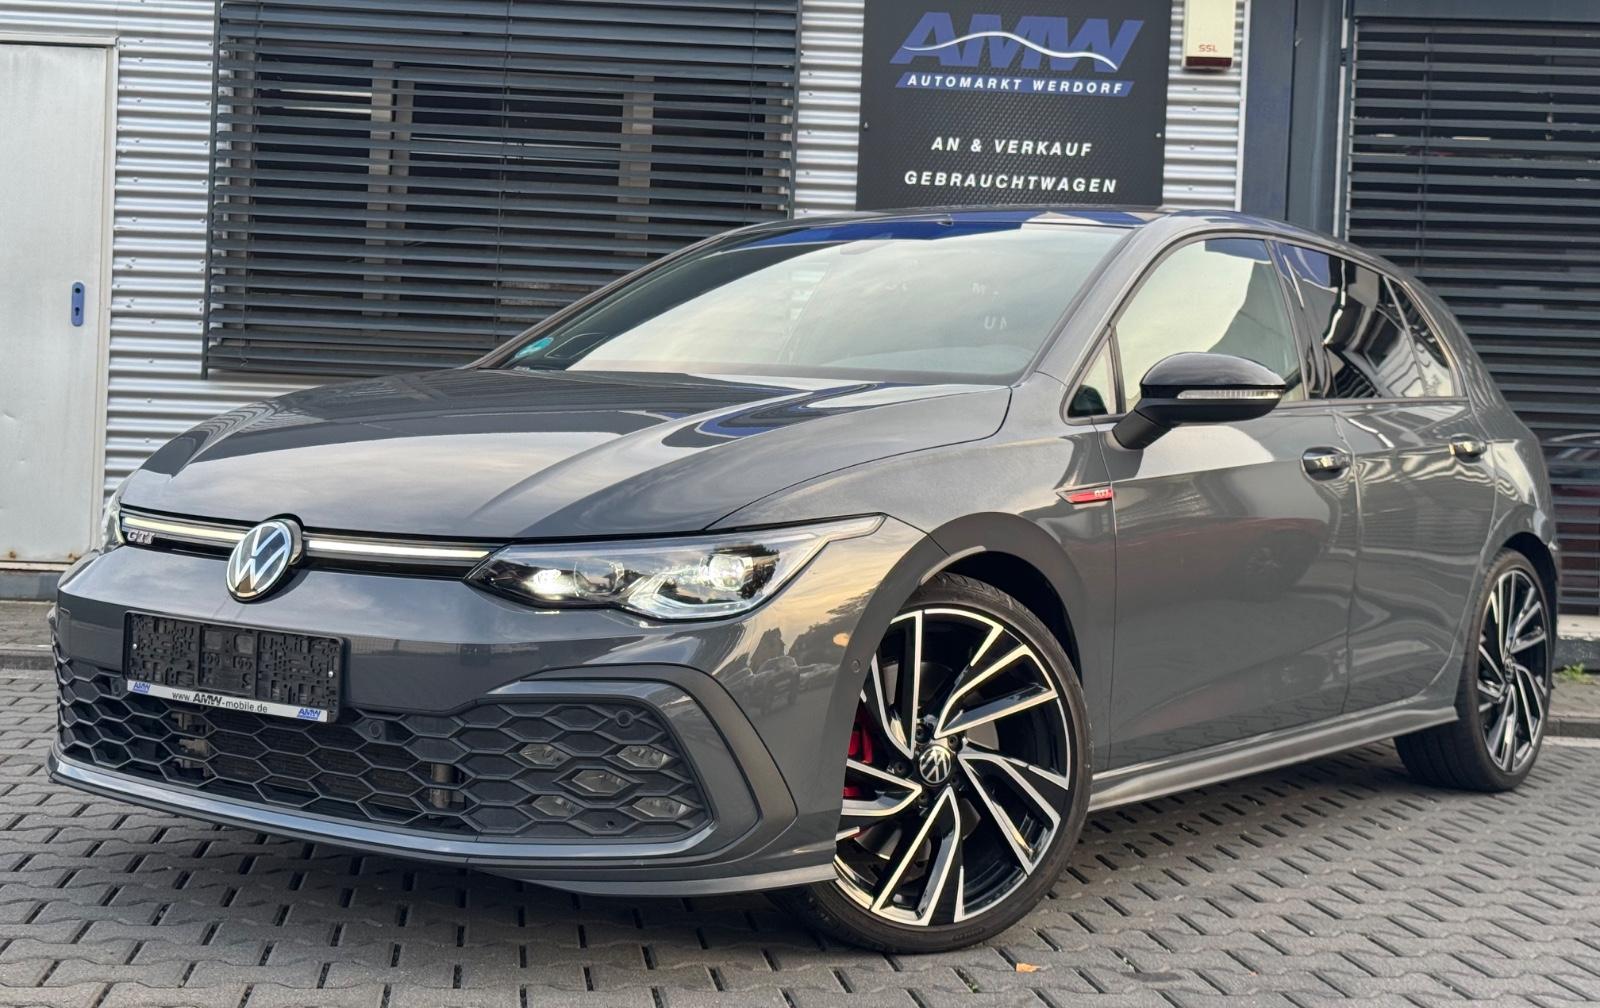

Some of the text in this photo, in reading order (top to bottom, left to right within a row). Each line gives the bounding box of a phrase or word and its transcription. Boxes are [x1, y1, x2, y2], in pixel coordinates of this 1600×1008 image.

[890, 12, 1145, 72] AMW
[907, 74, 1124, 94] AUTOMARKT WERDORF
[931, 136, 1093, 157] AN & VERKAUF
[904, 170, 1118, 194] GEBRAUCHTWAGEN
[127, 529, 155, 545] GTI
[298, 708, 321, 719] AMW
